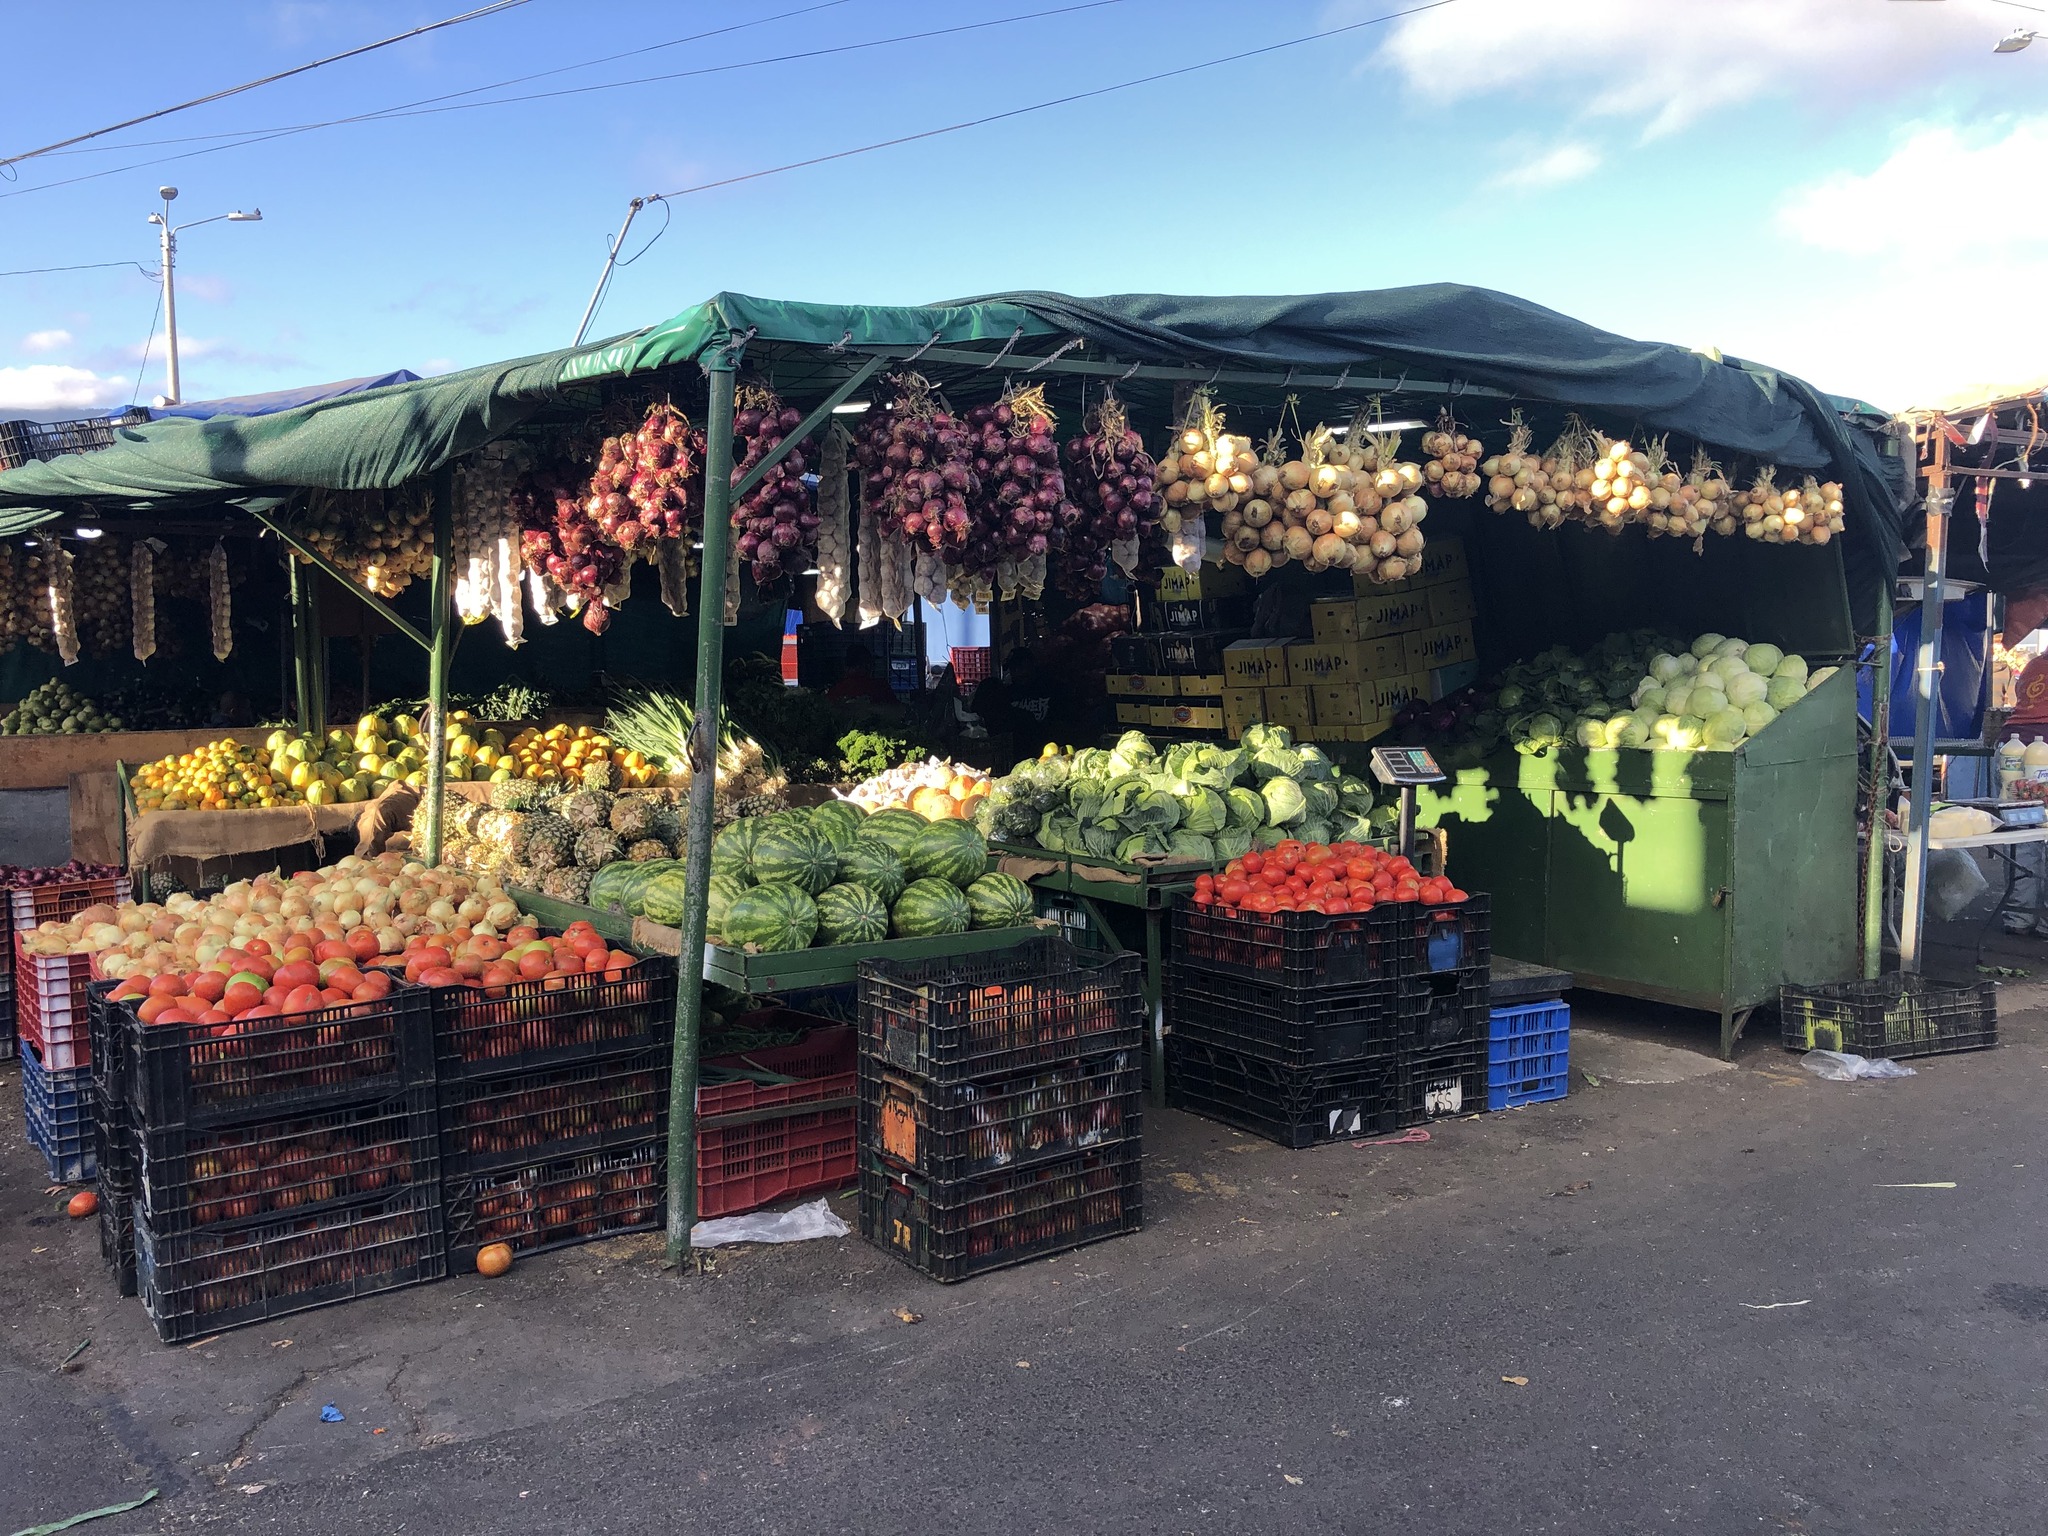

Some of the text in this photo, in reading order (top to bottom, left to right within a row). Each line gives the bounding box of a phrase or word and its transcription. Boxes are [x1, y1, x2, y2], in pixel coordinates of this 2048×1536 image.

[1164, 575, 1190, 590] JIMAP
[1170, 610, 1198, 623] JIMAP
[1377, 604, 1418, 623] JIMAP
[1166, 647, 1195, 660] JIMAP
[1423, 635, 1461, 656] JIMAP
[1237, 659, 1272, 674] JIMAP
[1302, 656, 1341, 672] JIMAP
[1378, 687, 1419, 707] JIMAP
[893, 1218, 912, 1253] JR
